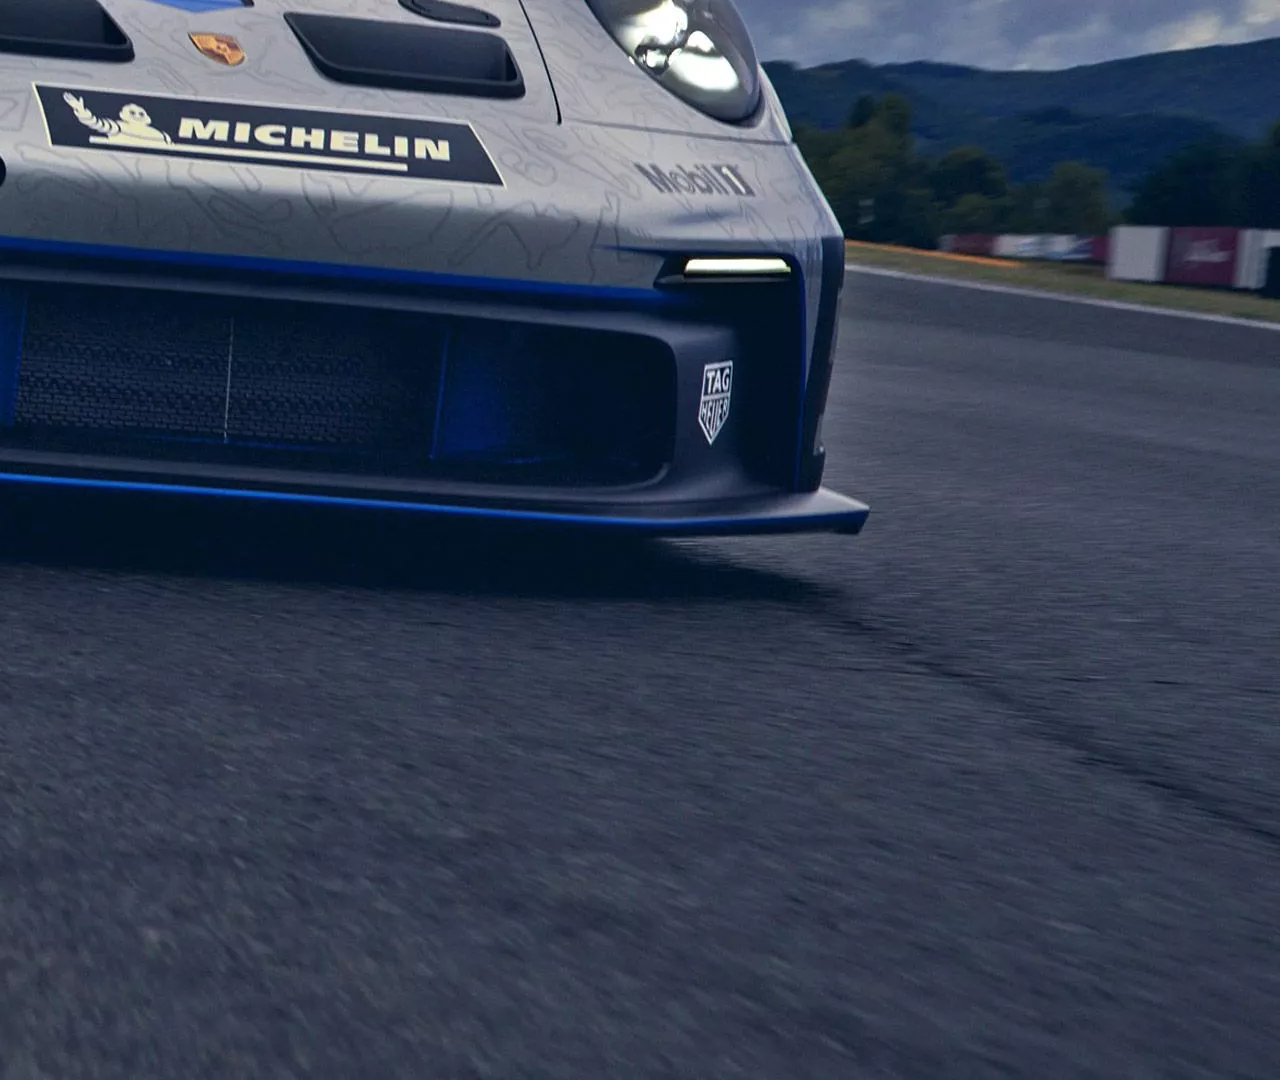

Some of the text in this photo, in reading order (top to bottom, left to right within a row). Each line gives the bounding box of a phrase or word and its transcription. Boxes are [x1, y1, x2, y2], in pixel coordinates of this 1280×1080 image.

[178, 117, 451, 161] MICHELIN
[632, 161, 729, 195] Mobil
[706, 368, 730, 394] TAG
[701, 399, 728, 436] HEUER
